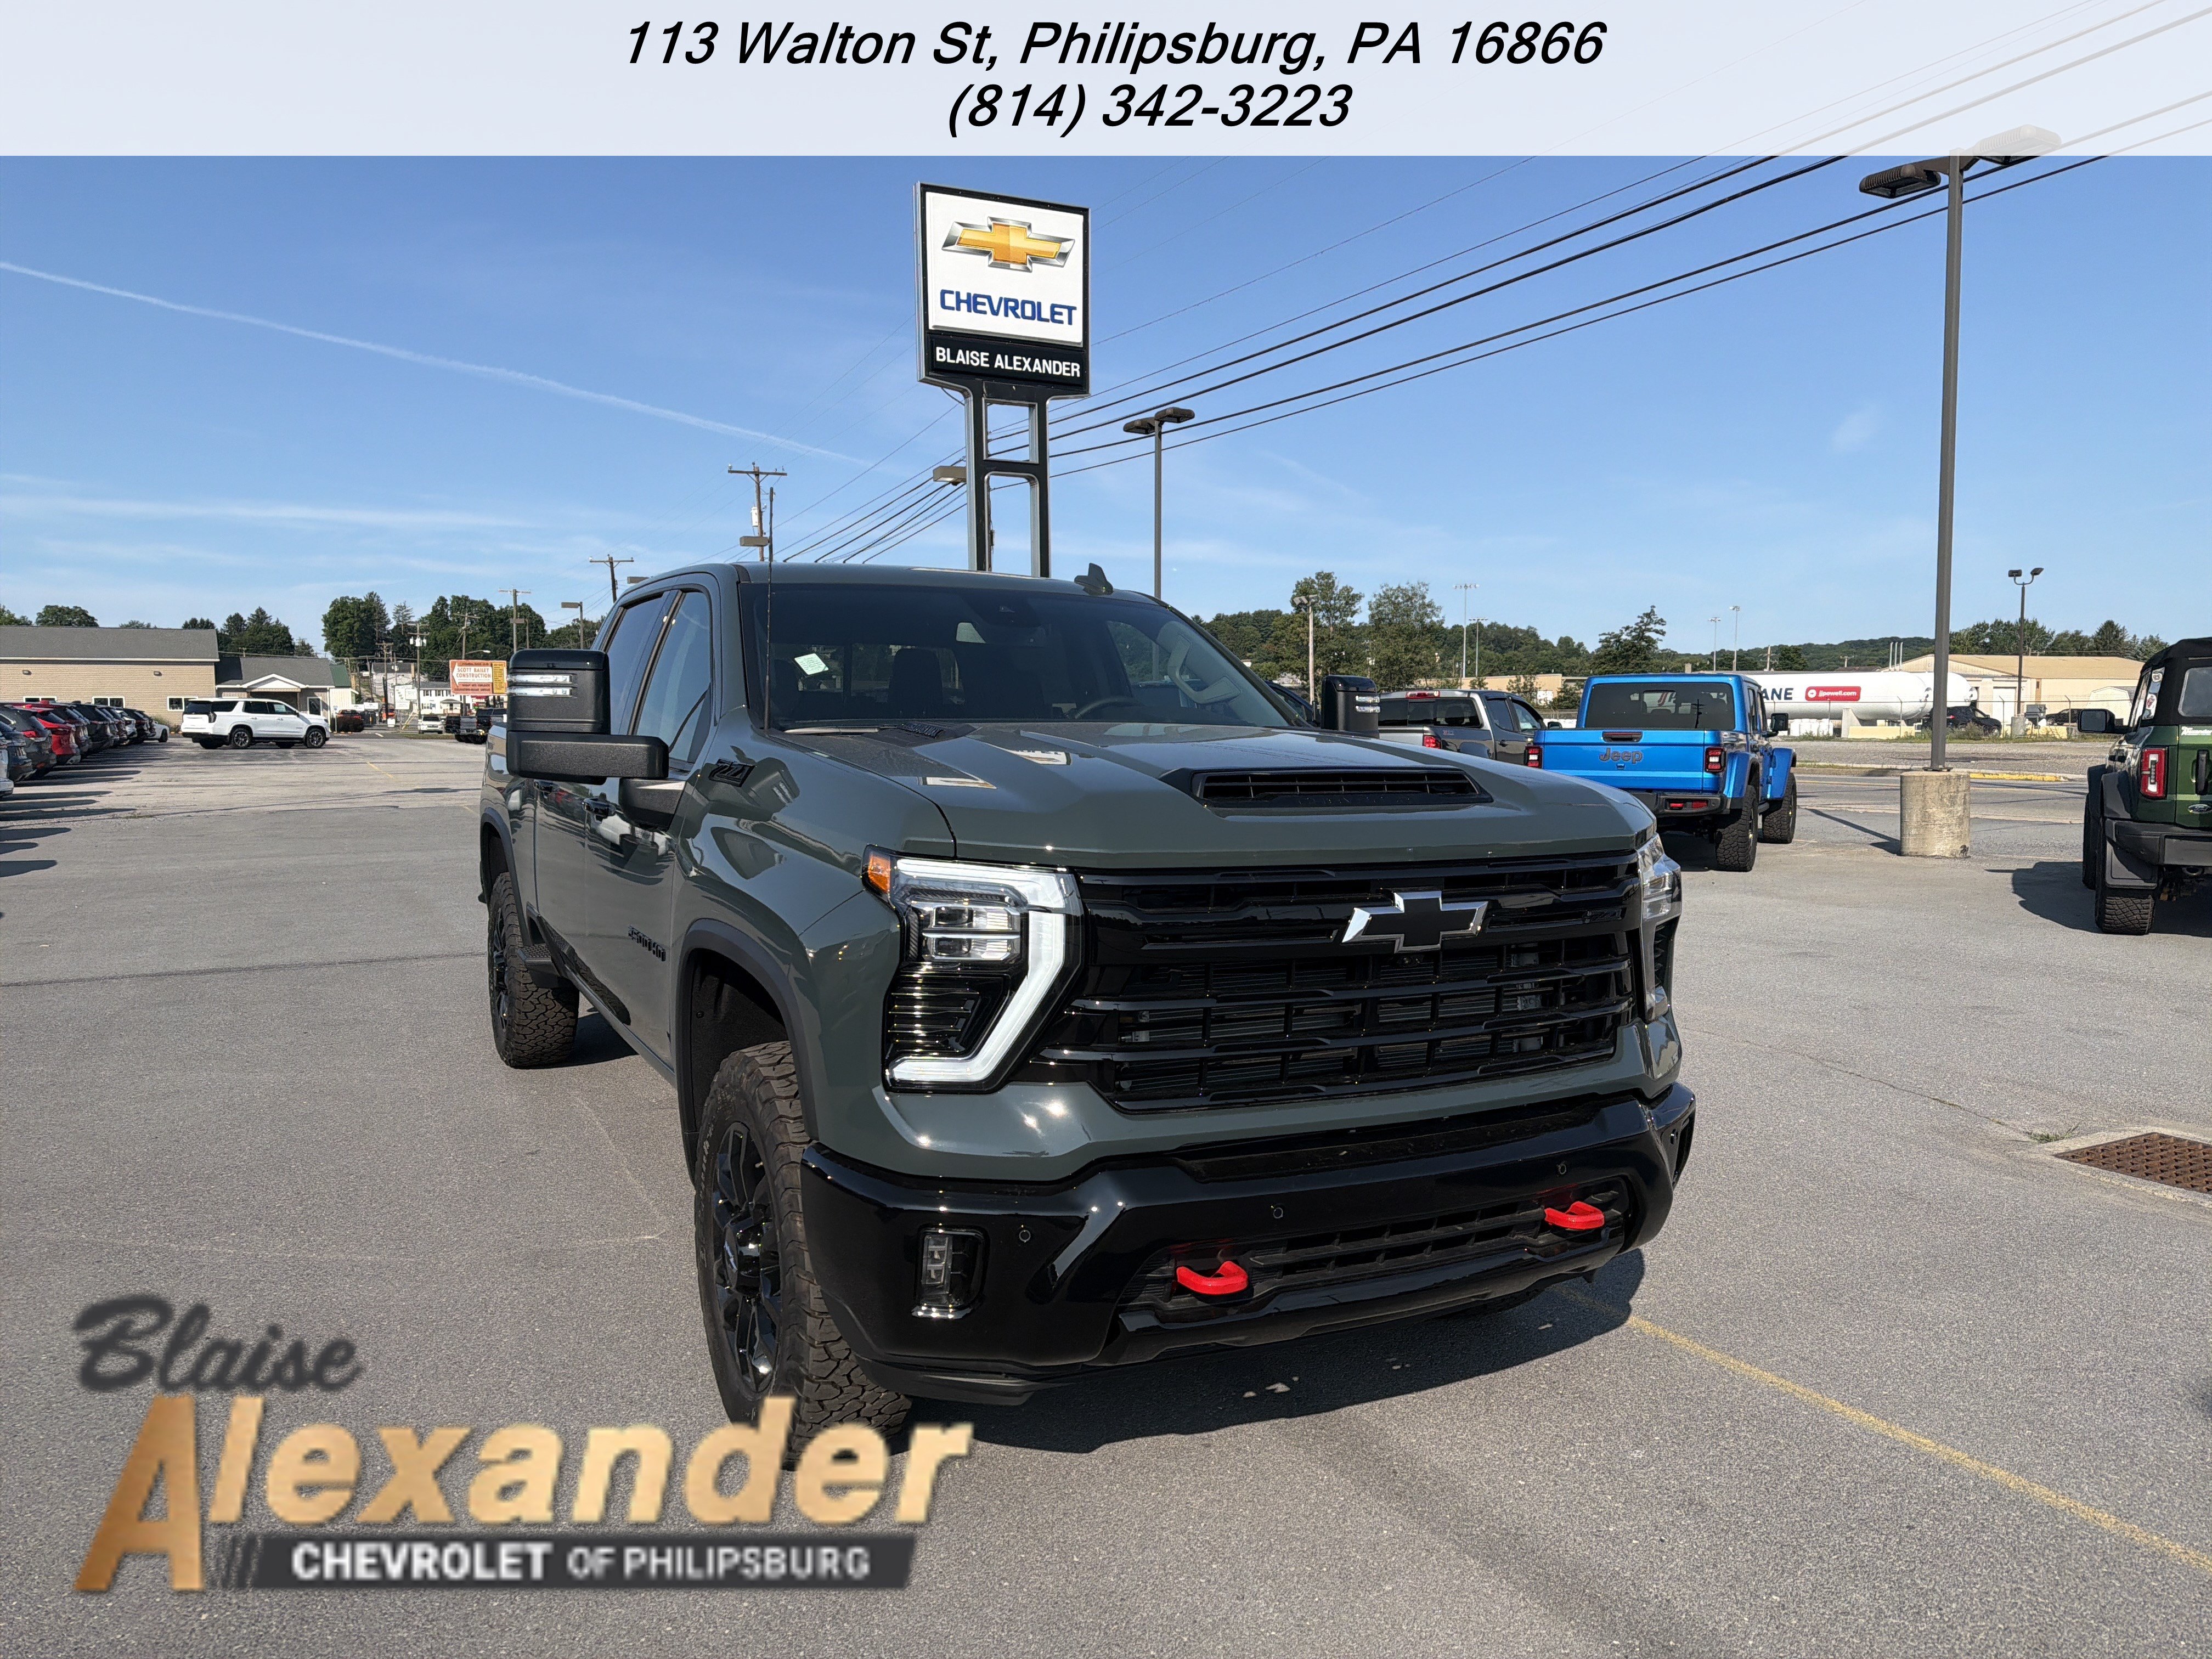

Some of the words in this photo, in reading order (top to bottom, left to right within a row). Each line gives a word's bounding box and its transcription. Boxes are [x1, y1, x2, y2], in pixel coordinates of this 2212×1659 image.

[940, 289, 1077, 325] CHEVROLET
[935, 346, 989, 367] BLAISE
[994, 353, 1080, 377] ALEXANDER
[1599, 747, 1643, 764] Jeep
